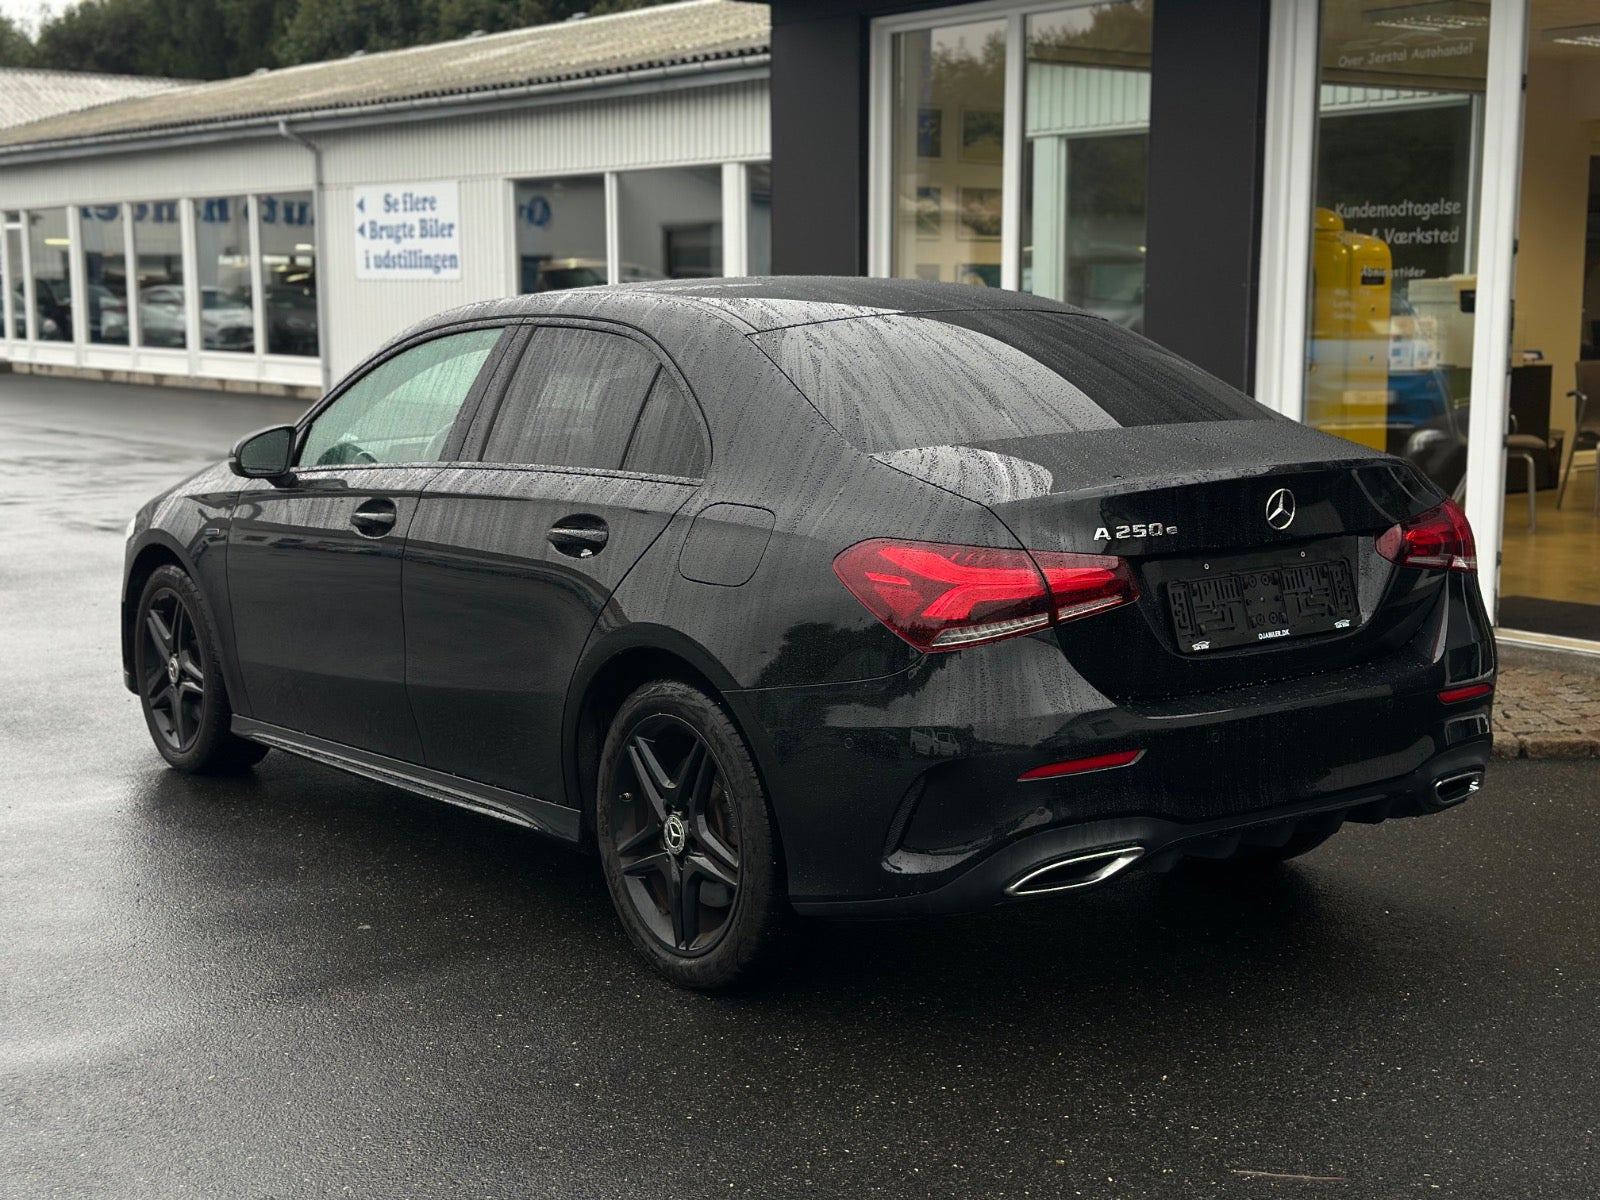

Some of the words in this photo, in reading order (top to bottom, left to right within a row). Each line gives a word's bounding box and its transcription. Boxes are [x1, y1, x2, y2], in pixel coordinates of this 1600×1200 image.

[1411, 42, 1474, 59] Autohandel
[383, 192, 400, 213] Se
[402, 192, 437, 212] flere
[1335, 198, 1462, 221] Kundemodtagelse
[369, 220, 415, 244] Brugte
[419, 218, 455, 239] Biler
[1384, 225, 1460, 245] Værksted
[364, 250, 370, 269] i
[373, 249, 459, 275] udstillingen
[1093, 527, 1112, 541] A
